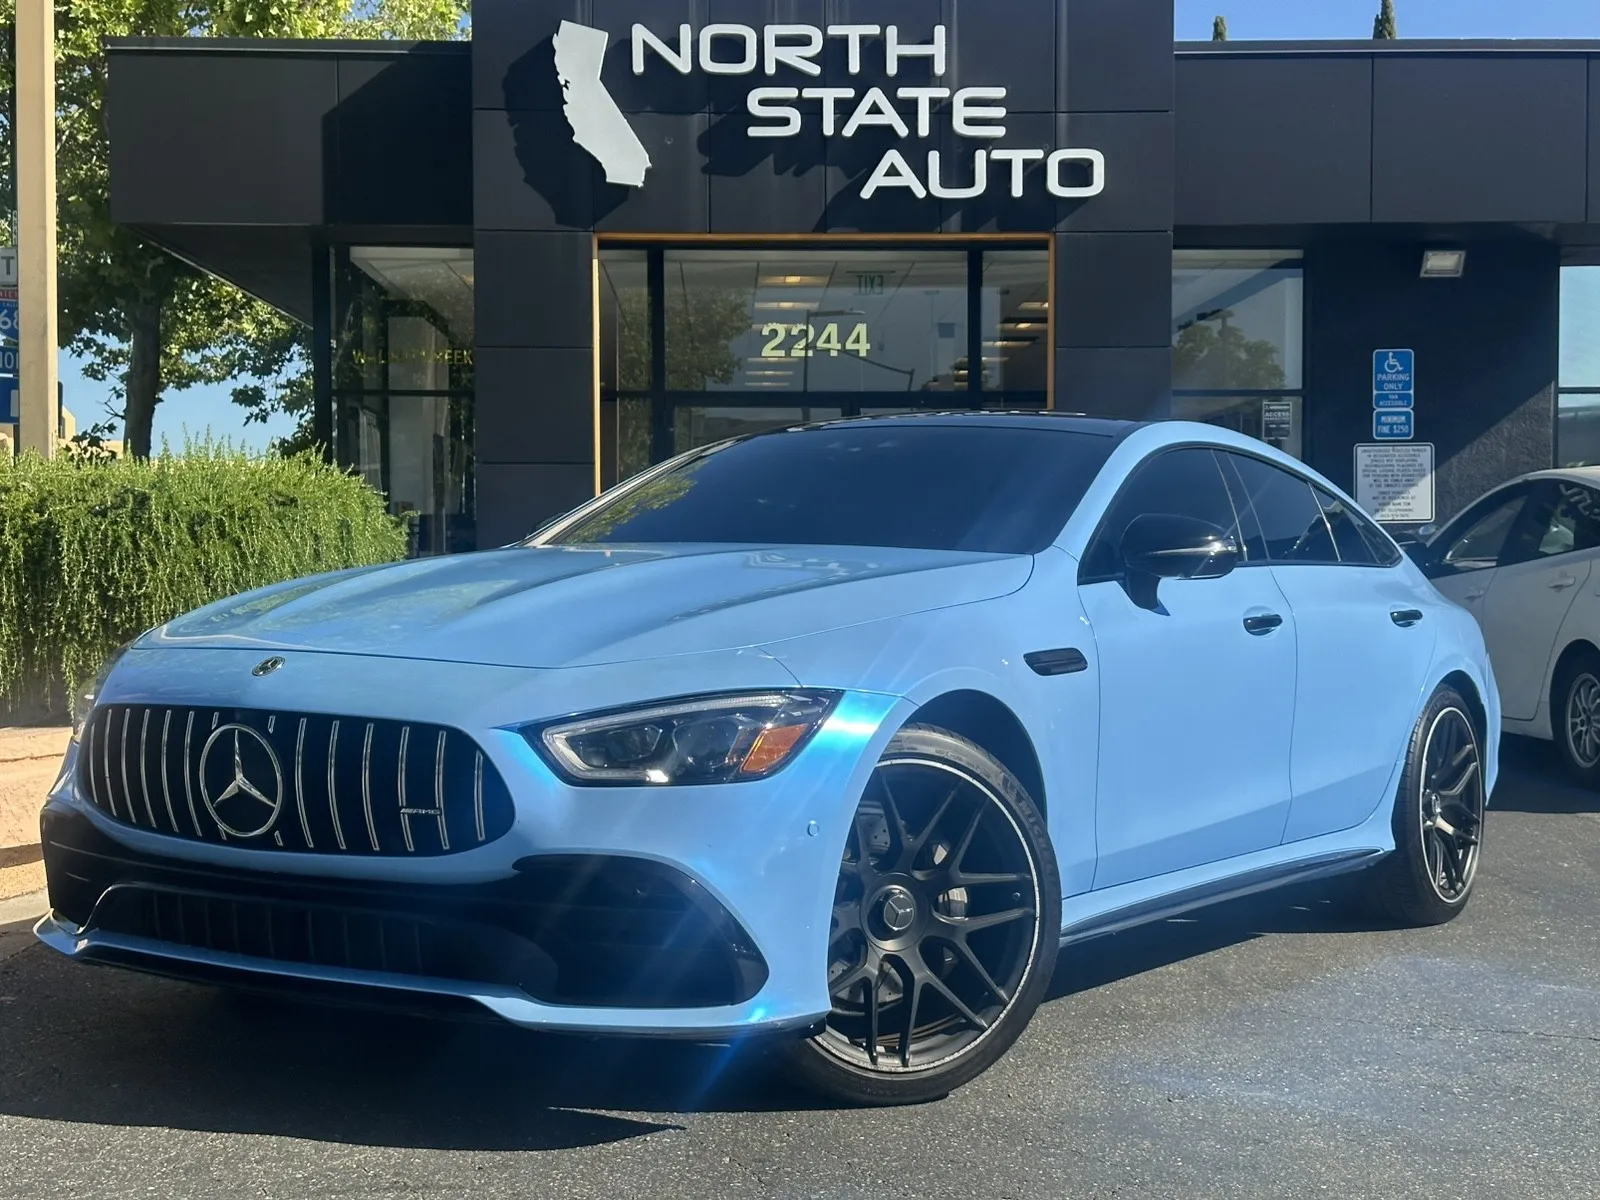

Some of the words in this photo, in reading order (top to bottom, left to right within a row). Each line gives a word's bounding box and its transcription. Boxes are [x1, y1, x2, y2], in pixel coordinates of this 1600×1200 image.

[631, 23, 946, 76] NORTH
[747, 87, 1006, 138] STATE
[859, 149, 1105, 199] AUTO
[761, 322, 871, 357] 2244
[1377, 373, 1410, 381] PARKING
[1383, 382, 1403, 390] ONLY
[1377, 425, 1391, 434] FINE
[1393, 425, 1409, 434] $250
